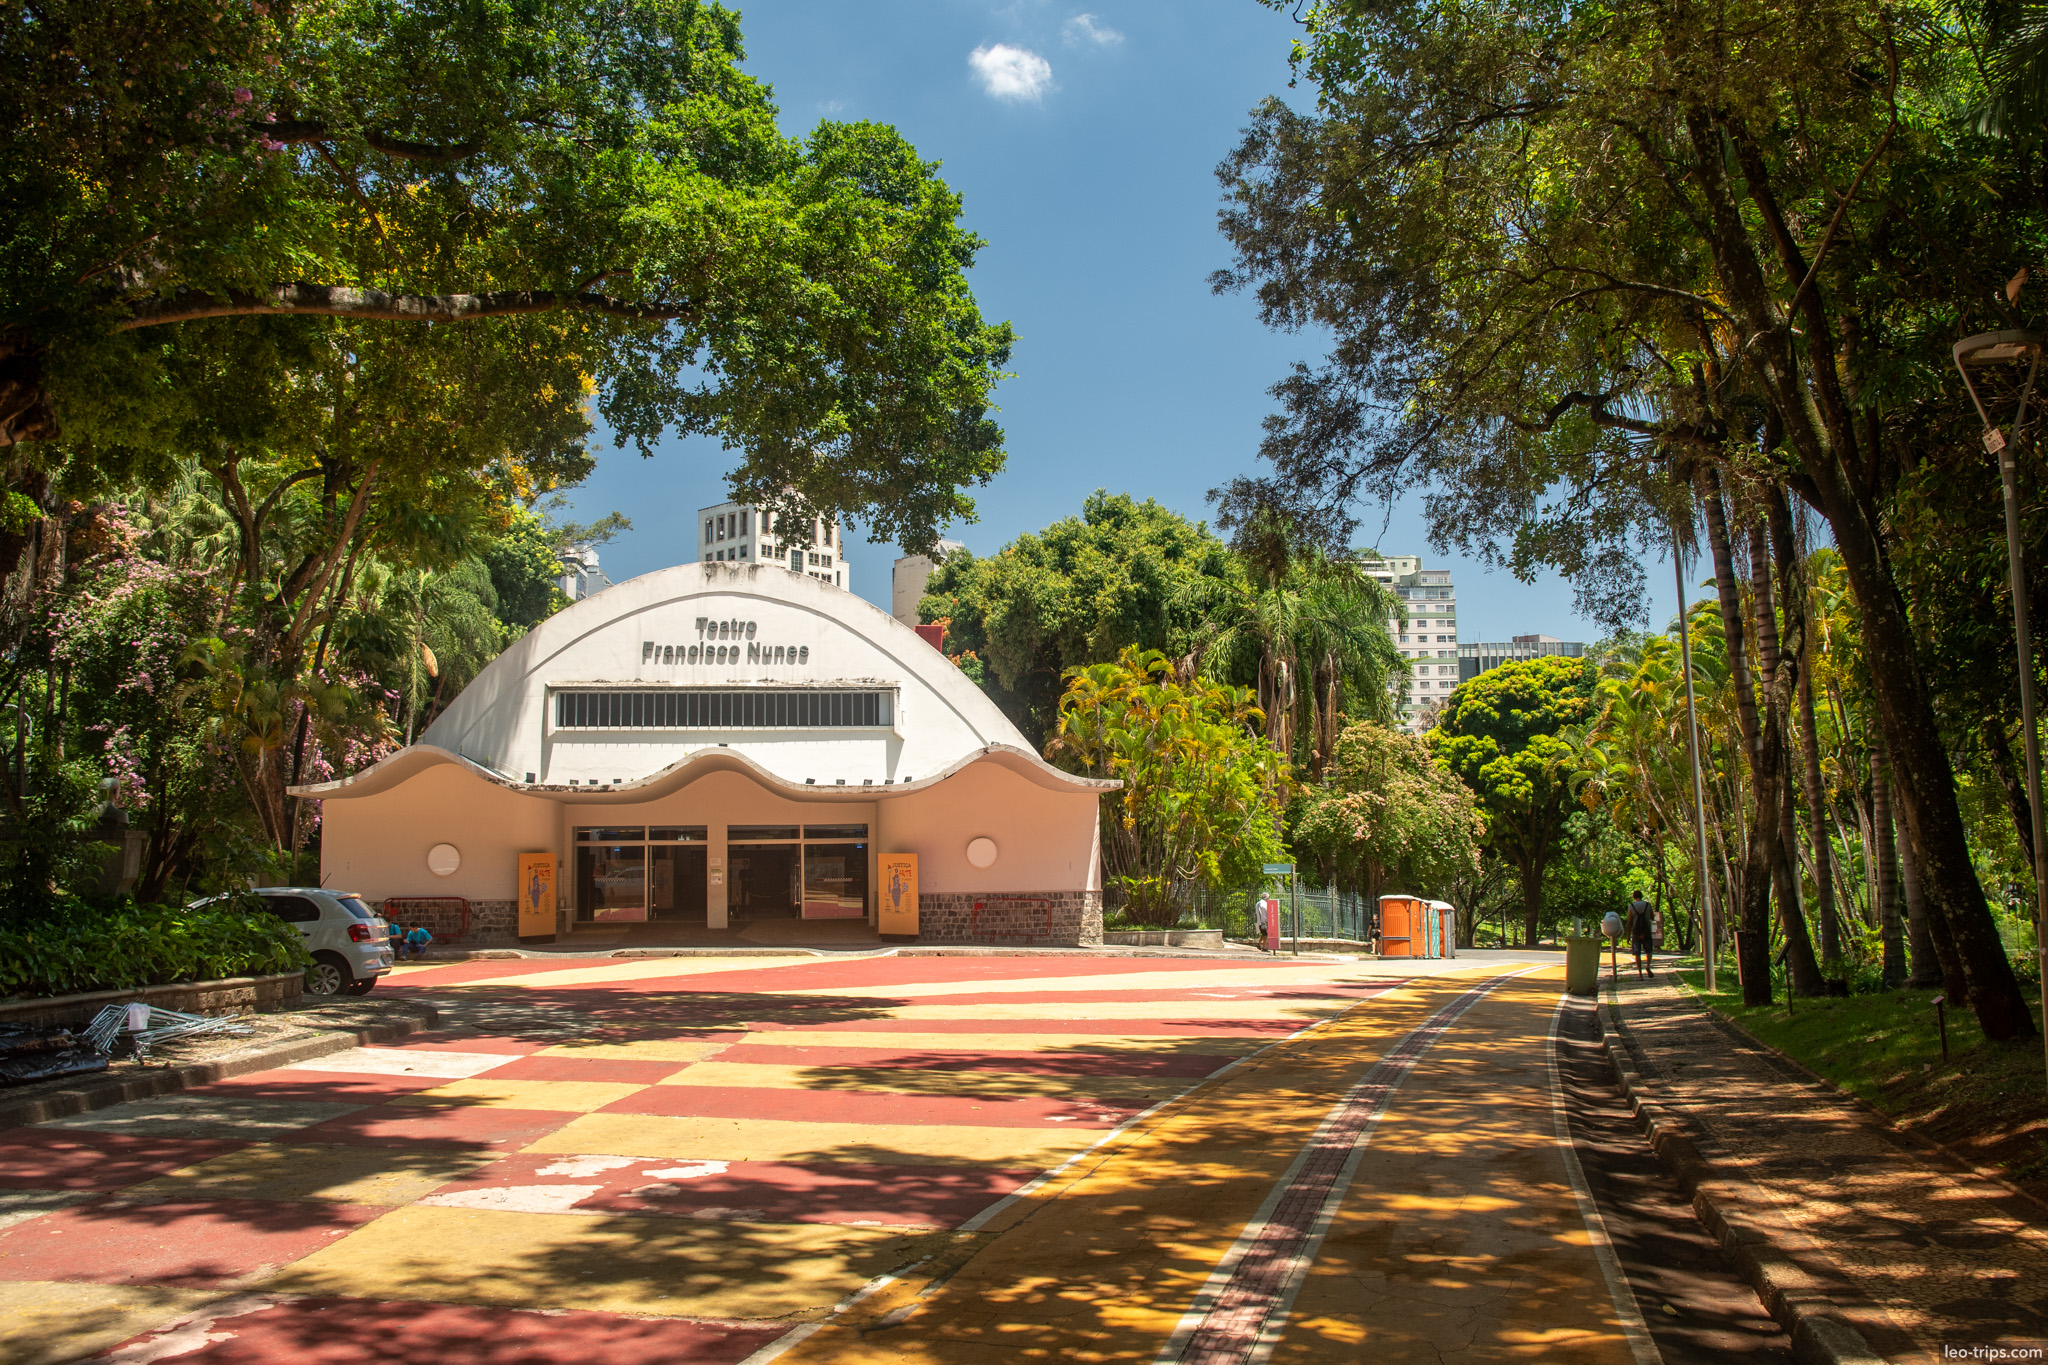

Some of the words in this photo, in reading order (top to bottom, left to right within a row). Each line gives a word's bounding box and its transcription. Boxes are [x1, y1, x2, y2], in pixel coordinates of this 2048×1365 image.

[695, 617, 758, 635] Teatro
[642, 641, 741, 660] Francisco
[747, 641, 810, 660] Nunes
